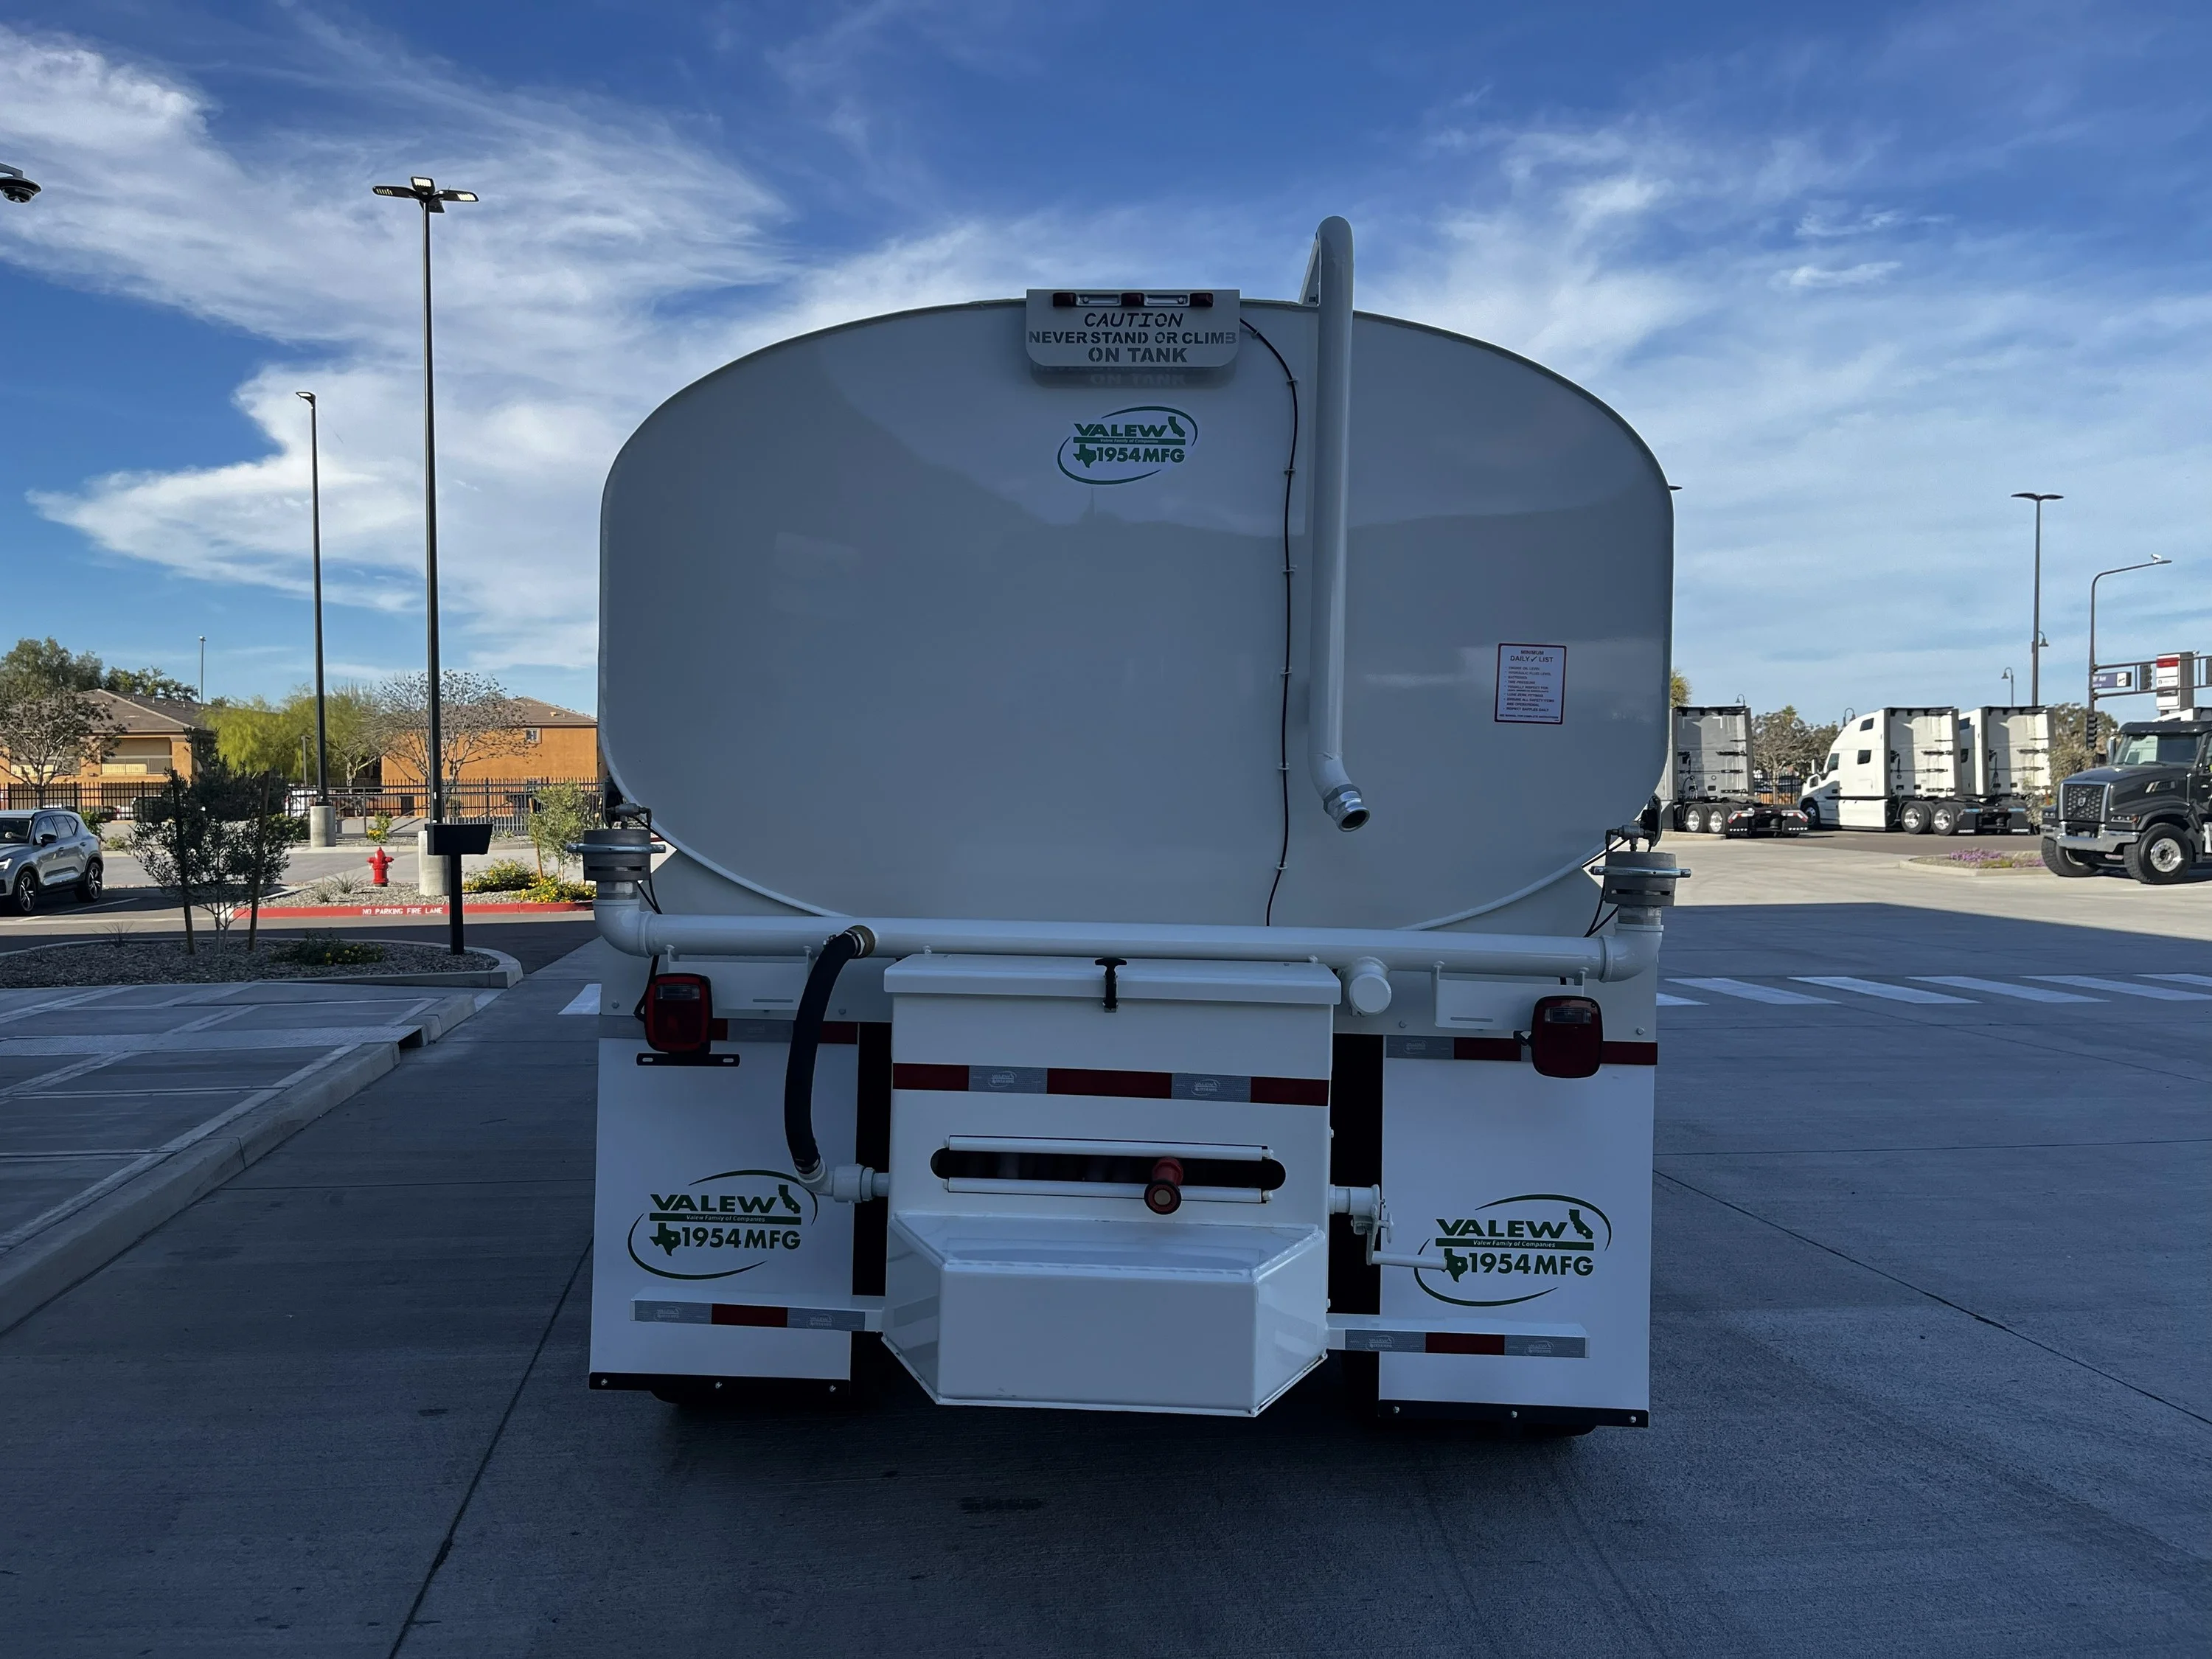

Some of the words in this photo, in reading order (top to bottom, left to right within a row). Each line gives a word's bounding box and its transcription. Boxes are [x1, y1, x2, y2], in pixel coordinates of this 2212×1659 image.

[1084, 313, 1183, 327] CAUTION
[1029, 332, 1088, 344] NEVER
[1091, 332, 1148, 344] STAND
[1155, 332, 1178, 344] OR
[1182, 333, 1237, 344] CLIMB
[1088, 347, 1119, 363] ON
[1127, 347, 1187, 363] TANK
[1074, 423, 1168, 437] VALEW
[650, 1194, 777, 1214] VALEW
[1436, 1219, 1568, 1239] VALEW
